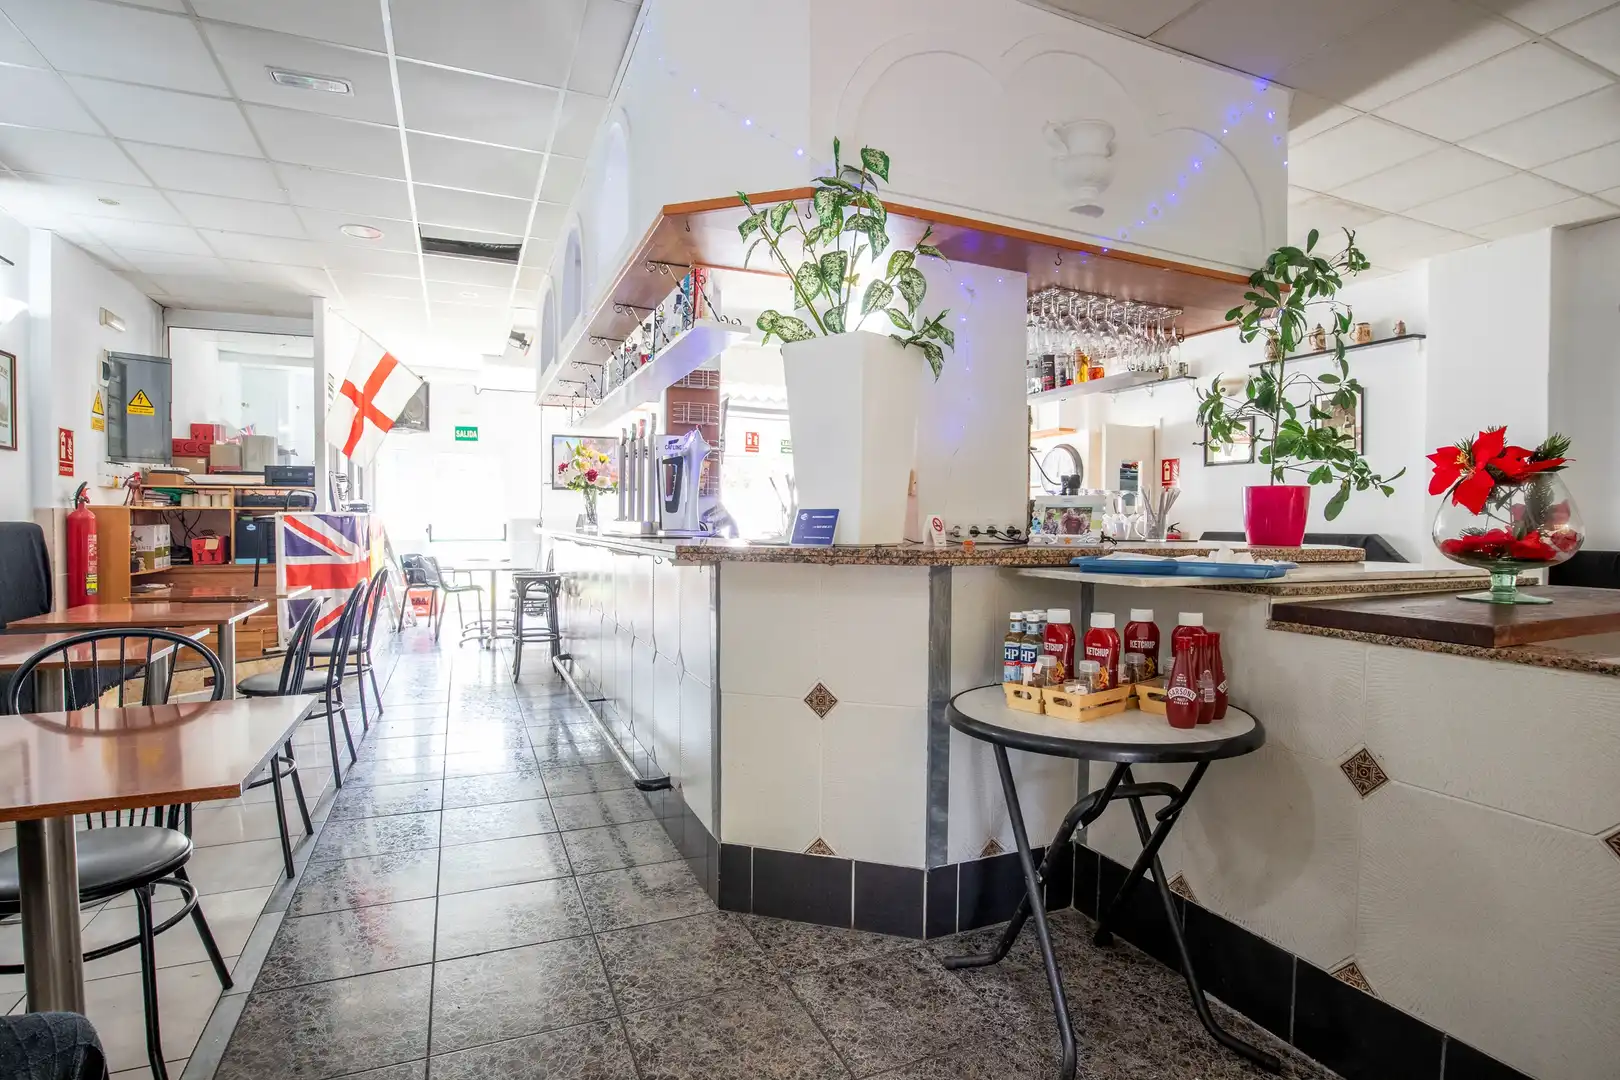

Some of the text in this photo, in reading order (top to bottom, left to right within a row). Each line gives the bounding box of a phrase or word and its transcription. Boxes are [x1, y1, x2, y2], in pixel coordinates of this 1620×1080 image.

[456, 430, 478, 438] SALIDA
[1130, 640, 1156, 649] KETCHUP
[1004, 648, 1019, 660] HP
[1020, 649, 1036, 662] HP
[1086, 646, 1109, 657] KETCHUP
[1169, 688, 1195, 699] SARSONS
